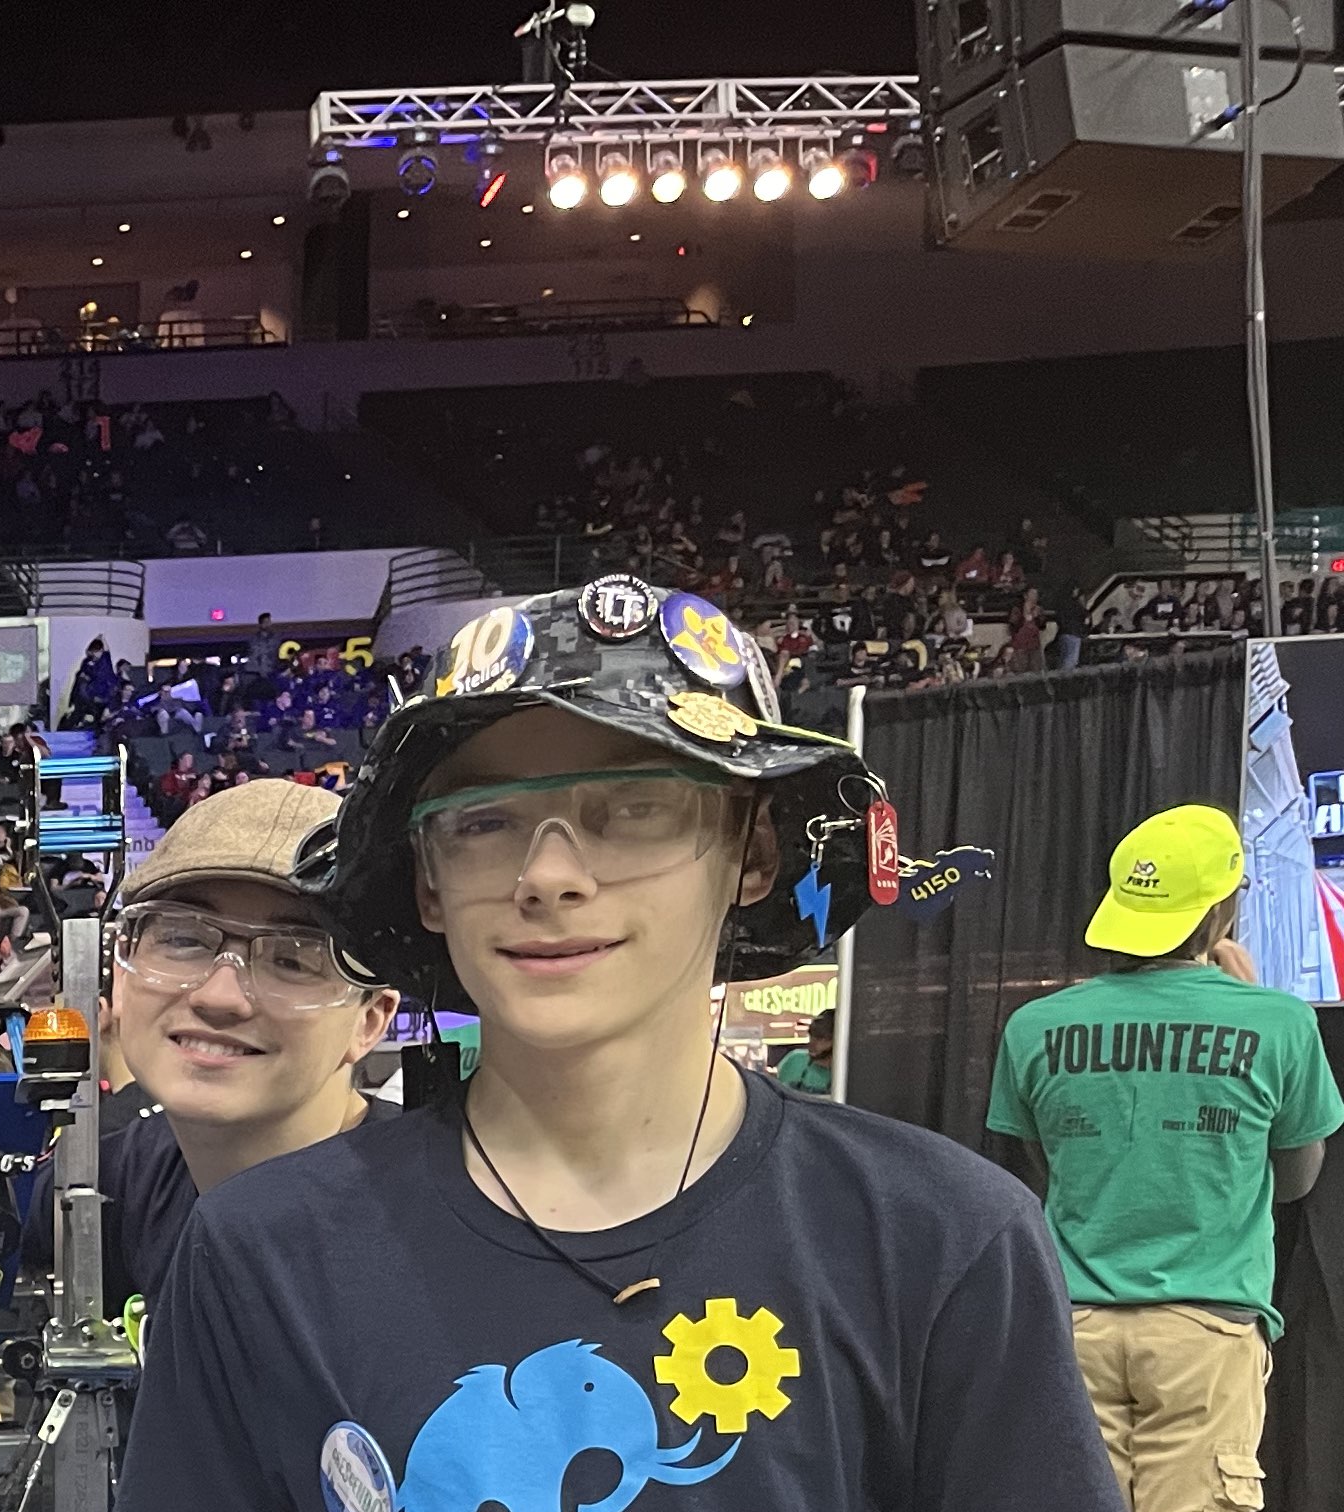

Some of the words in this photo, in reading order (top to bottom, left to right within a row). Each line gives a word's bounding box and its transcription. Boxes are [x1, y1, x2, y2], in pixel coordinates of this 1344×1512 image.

[454, 656, 509, 696] Stellar
[911, 866, 962, 901] 4150
[1126, 875, 1160, 888] FIRST
[1044, 1022, 1261, 1079] VOLUNTEER
[1196, 1104, 1241, 1134] SHOW
